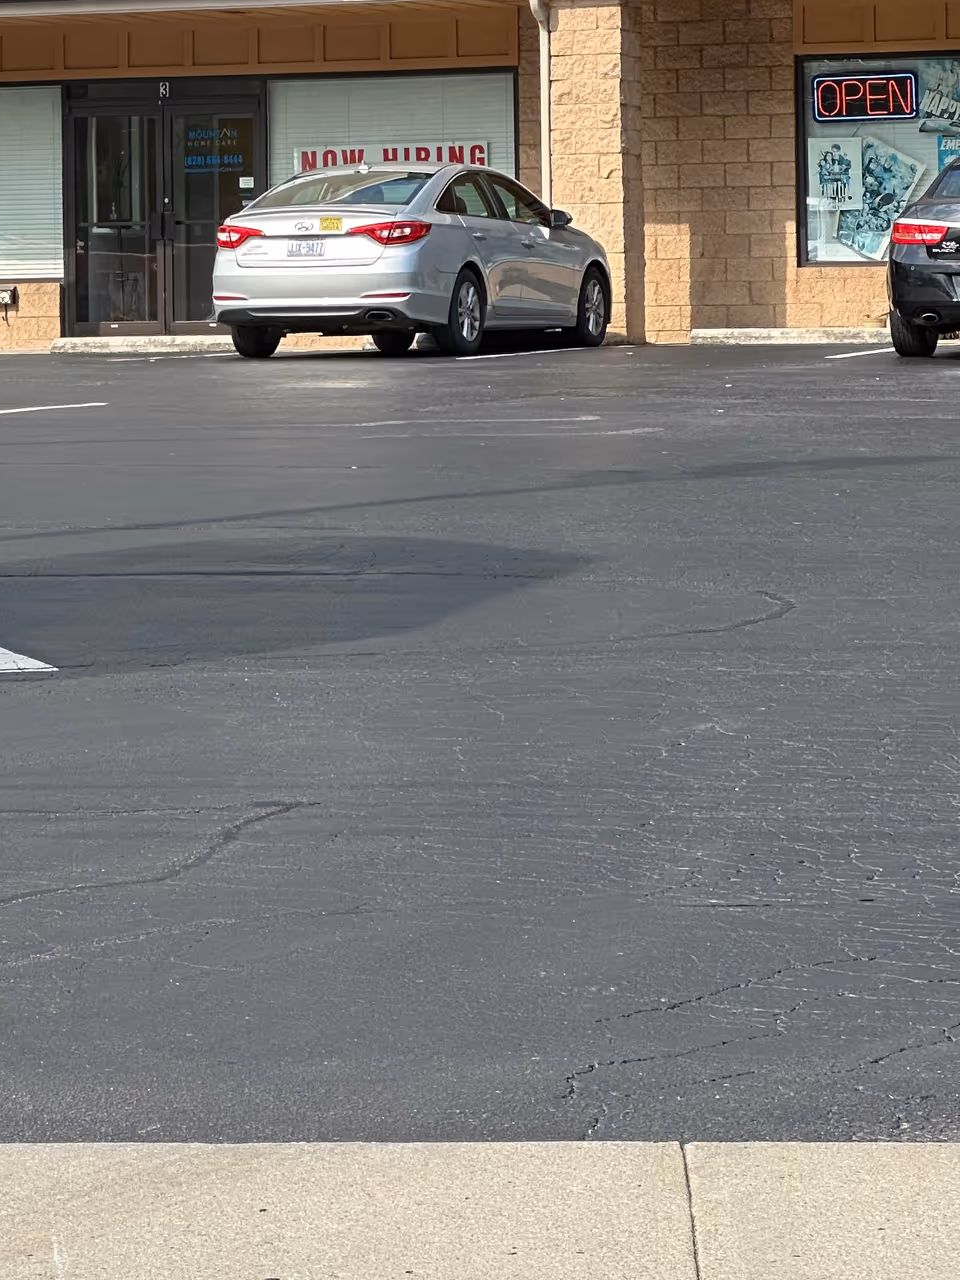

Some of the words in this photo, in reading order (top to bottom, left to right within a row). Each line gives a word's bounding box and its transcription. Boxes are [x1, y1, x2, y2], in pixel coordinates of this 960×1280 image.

[160, 82, 168, 98] 3
[818, 79, 911, 116] OPEN
[301, 148, 365, 173] NOW
[383, 144, 486, 167] HIRING
